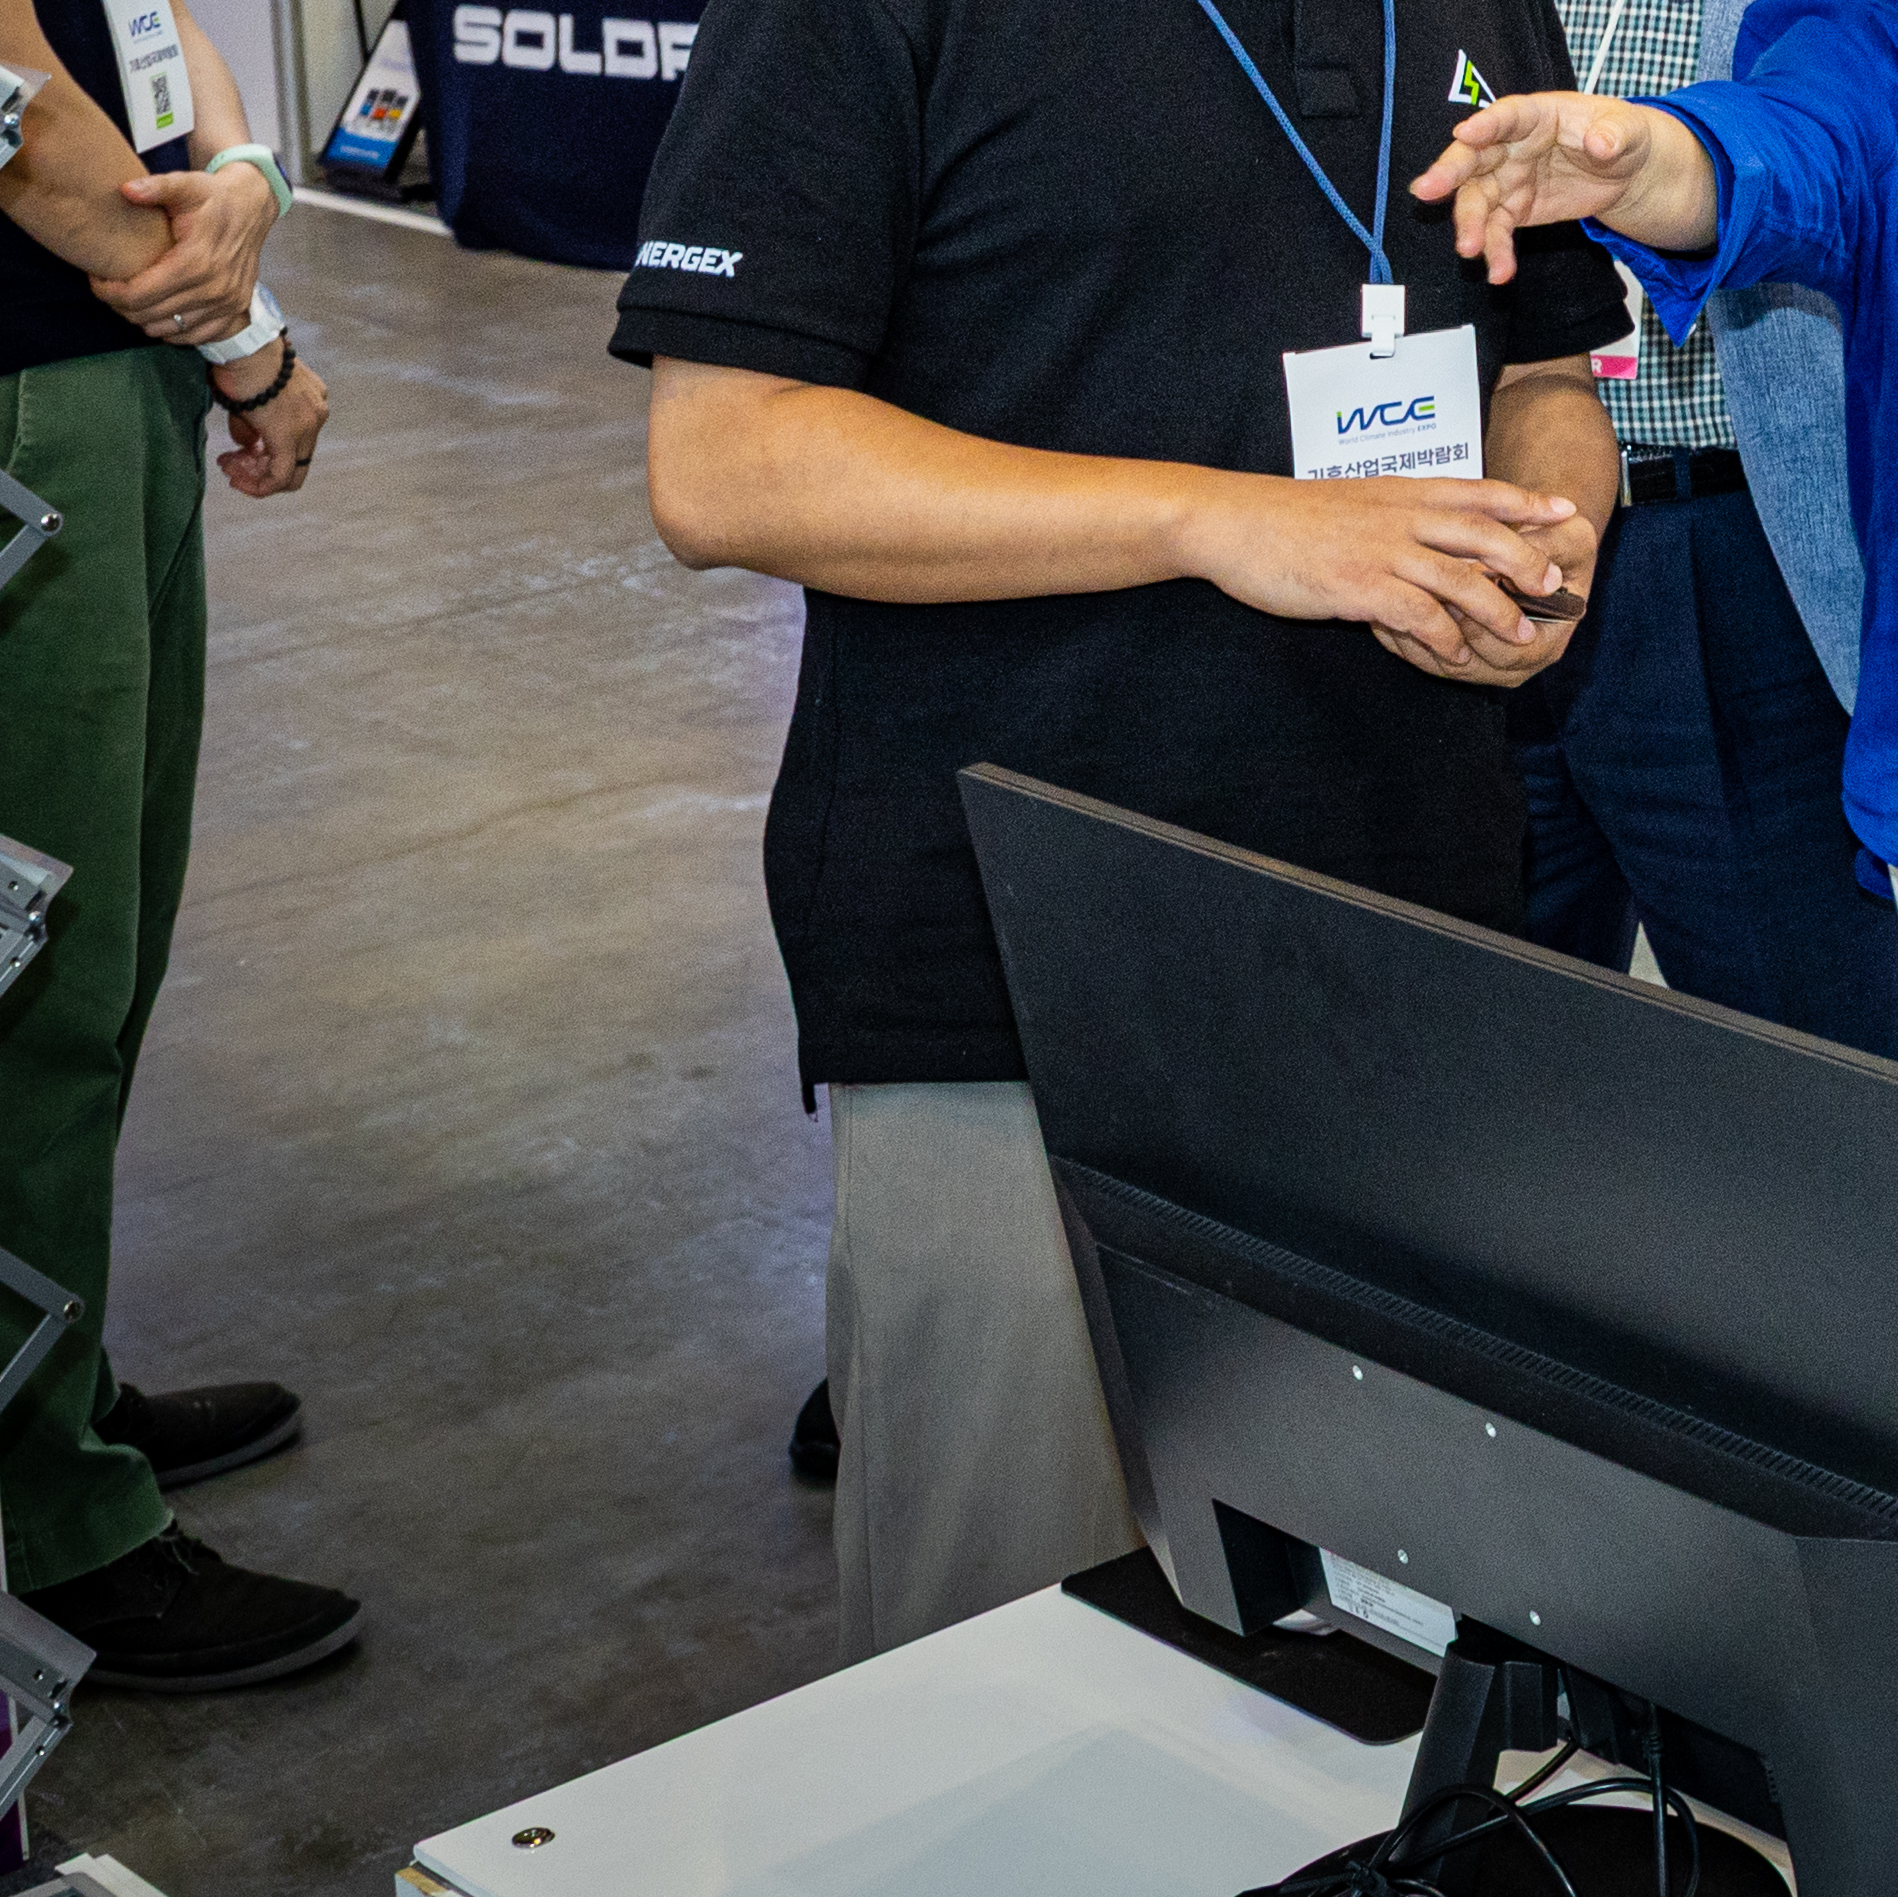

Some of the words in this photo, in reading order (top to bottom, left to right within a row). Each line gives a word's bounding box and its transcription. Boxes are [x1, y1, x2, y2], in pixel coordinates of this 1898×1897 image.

[128, 11, 161, 38] WCE
[1337, 396, 1436, 434] WCE
[1417, 423, 1437, 432] EXPO
